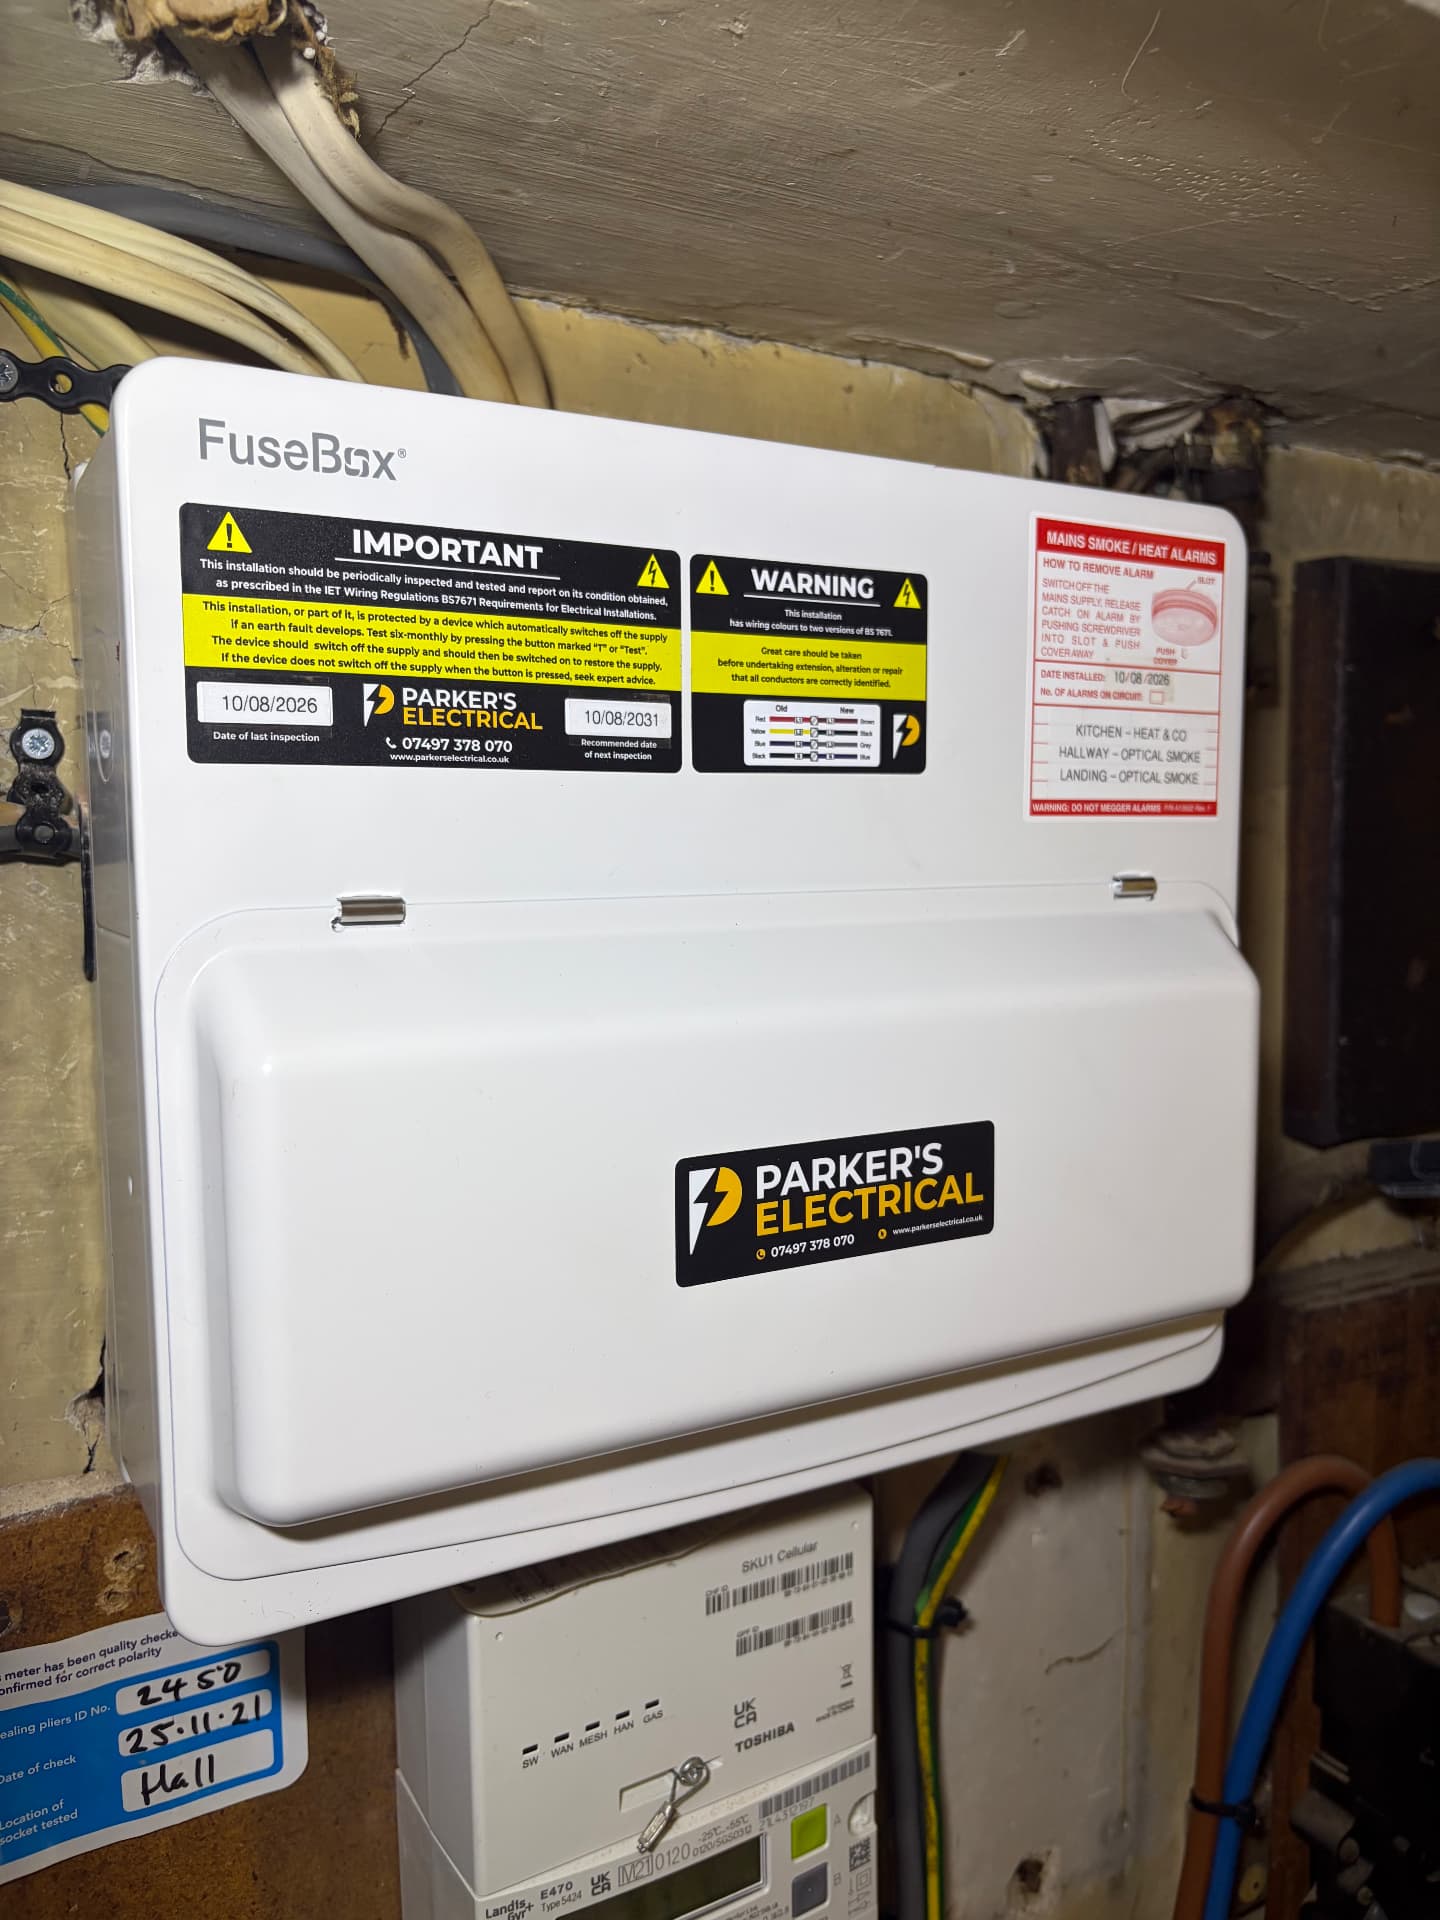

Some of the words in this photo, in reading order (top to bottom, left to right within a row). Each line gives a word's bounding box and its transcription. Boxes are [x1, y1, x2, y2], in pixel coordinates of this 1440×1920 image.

[353, 528, 543, 569] IMPORTANT
[1046, 530, 1085, 548] MAINS
[1088, 536, 1130, 554] SMOKE
[1131, 542, 1137, 554] /
[1138, 543, 1168, 558] HEAT
[1170, 547, 1216, 565] ALARMS
[1043, 557, 1065, 569] HOW
[1067, 560, 1080, 571] TO
[1082, 562, 1120, 576] REMOVE
[1123, 567, 1154, 579] ALARM
[199, 558, 223, 569] This
[226, 559, 285, 574] installation
[288, 565, 323, 577] should
[326, 568, 339, 578] be
[342, 570, 401, 585] periodically
[404, 574, 452, 587] inspected
[454, 580, 473, 589] and
[475, 581, 505, 591] tested
[508, 584, 525, 593] and
[527, 587, 556, 596] report
[558, 589, 570, 597] on
[572, 588, 583, 598] its
[585, 591, 625, 602] condition
[627, 594, 667, 606] obtained,
[750, 568, 873, 598] WARNING
[202, 600, 225, 611] This
[228, 602, 291, 617] installation,
[293, 608, 304, 616] or
[307, 609, 329, 619] part
[331, 609, 342, 618] of
[344, 610, 354, 621] it,
[357, 610, 365, 620] is
[367, 613, 416, 623] protected
[419, 615, 431, 626] by
[433, 617, 439, 625] a
[441, 616, 473, 627] device
[475, 619, 504, 630] which
[506, 623, 568, 636] automatically
[569, 626, 608, 637] switches
[609, 629, 622, 638] off
[623, 630, 638, 639] the
[639, 632, 667, 643] supply
[784, 609, 800, 617] This
[801, 609, 842, 620] installation
[729, 618, 743, 627] has
[744, 619, 769, 630] wiring
[771, 622, 798, 630] colours
[809, 624, 823, 632] two
[824, 625, 854, 634] versions
[864, 627, 874, 635] BS
[761, 646, 782, 655] Great
[802, 649, 828, 658] should
[829, 650, 839, 658] be
[840, 651, 862, 659] taken
[717, 658, 744, 667] before
[745, 660, 793, 671] undertaking
[795, 663, 834, 673] extension,
[835, 664, 871, 673] alteration
[881, 666, 903, 675] repair
[1040, 669, 1061, 679] DATE
[749, 674, 759, 682] all
[760, 675, 804, 684] conductors
[819, 678, 852, 687] correctly
[853, 678, 890, 687] identified.
[222, 695, 318, 713] 10/08/2026
[402, 687, 516, 711] PARKER'S
[775, 704, 787, 712] Old
[403, 706, 543, 729] ELECTRICAL
[585, 710, 658, 727] 10/08/2031
[213, 731, 236, 739] Date
[238, 731, 248, 740] of
[250, 731, 268, 740] last
[270, 731, 319, 742] inspection
[1075, 724, 1122, 738] KITCHEN
[1133, 727, 1160, 739] HEAT
[1162, 728, 1170, 741] &
[1171, 728, 1187, 742] CO
[402, 737, 449, 750] 07497
[453, 738, 480, 751] 378
[484, 739, 512, 752] 070
[581, 738, 638, 747] Recommended
[640, 740, 657, 748] date
[389, 753, 509, 763] www.parkerselectrical.co.uk
[584, 750, 592, 758] of
[612, 751, 651, 760] inspection
[1059, 746, 1109, 759] HALLWAY
[1120, 748, 1163, 761] OPTICAL
[1166, 750, 1200, 763] SMOKE
[1060, 768, 1107, 782] LANDING
[1118, 770, 1161, 783] OPTICAL
[1163, 771, 1198, 784] SMOKE
[756, 1142, 942, 1199] PARKER'S
[756, 1172, 983, 1236] ELECTRICAL
[892, 1214, 982, 1234] www.parkerselectrical.co.uk
[771, 1241, 806, 1257] 07497
[809, 1238, 830, 1250] 378
[833, 1233, 854, 1246] 070
[741, 1553, 772, 1573] SKU1
[777, 1541, 817, 1562] Cellular
[4, 1666, 40, 1680] meter
[44, 1662, 64, 1672] has
[67, 1652, 95, 1667] been
[98, 1640, 137, 1658] quality
[140, 1628, 178, 1645] checke
[0, 1675, 52, 1695] onfirmed
[55, 1670, 72, 1684] for
[75, 1658, 115, 1678] correct
[118, 1647, 161, 1667] polarity
[0, 1724, 35, 1739] ealing
[39, 1716, 71, 1731] pliers
[74, 1710, 87, 1721] ID
[90, 1705, 110, 1716] No.
[642, 1710, 663, 1723] GAS
[613, 1720, 634, 1734] HAN
[579, 1730, 607, 1747] MESH
[735, 1722, 794, 1752] TOSHIBA
[550, 1742, 573, 1758] WAN
[27, 1764, 40, 1774] of
[43, 1755, 76, 1769] check
[522, 1755, 538, 1768] SW
[140, 1753, 217, 1805] Hall
[51, 1799, 64, 1811] of
[0, 1824, 37, 1846] socket
[41, 1809, 77, 1829] tested
[540, 1881, 572, 1900] E470
